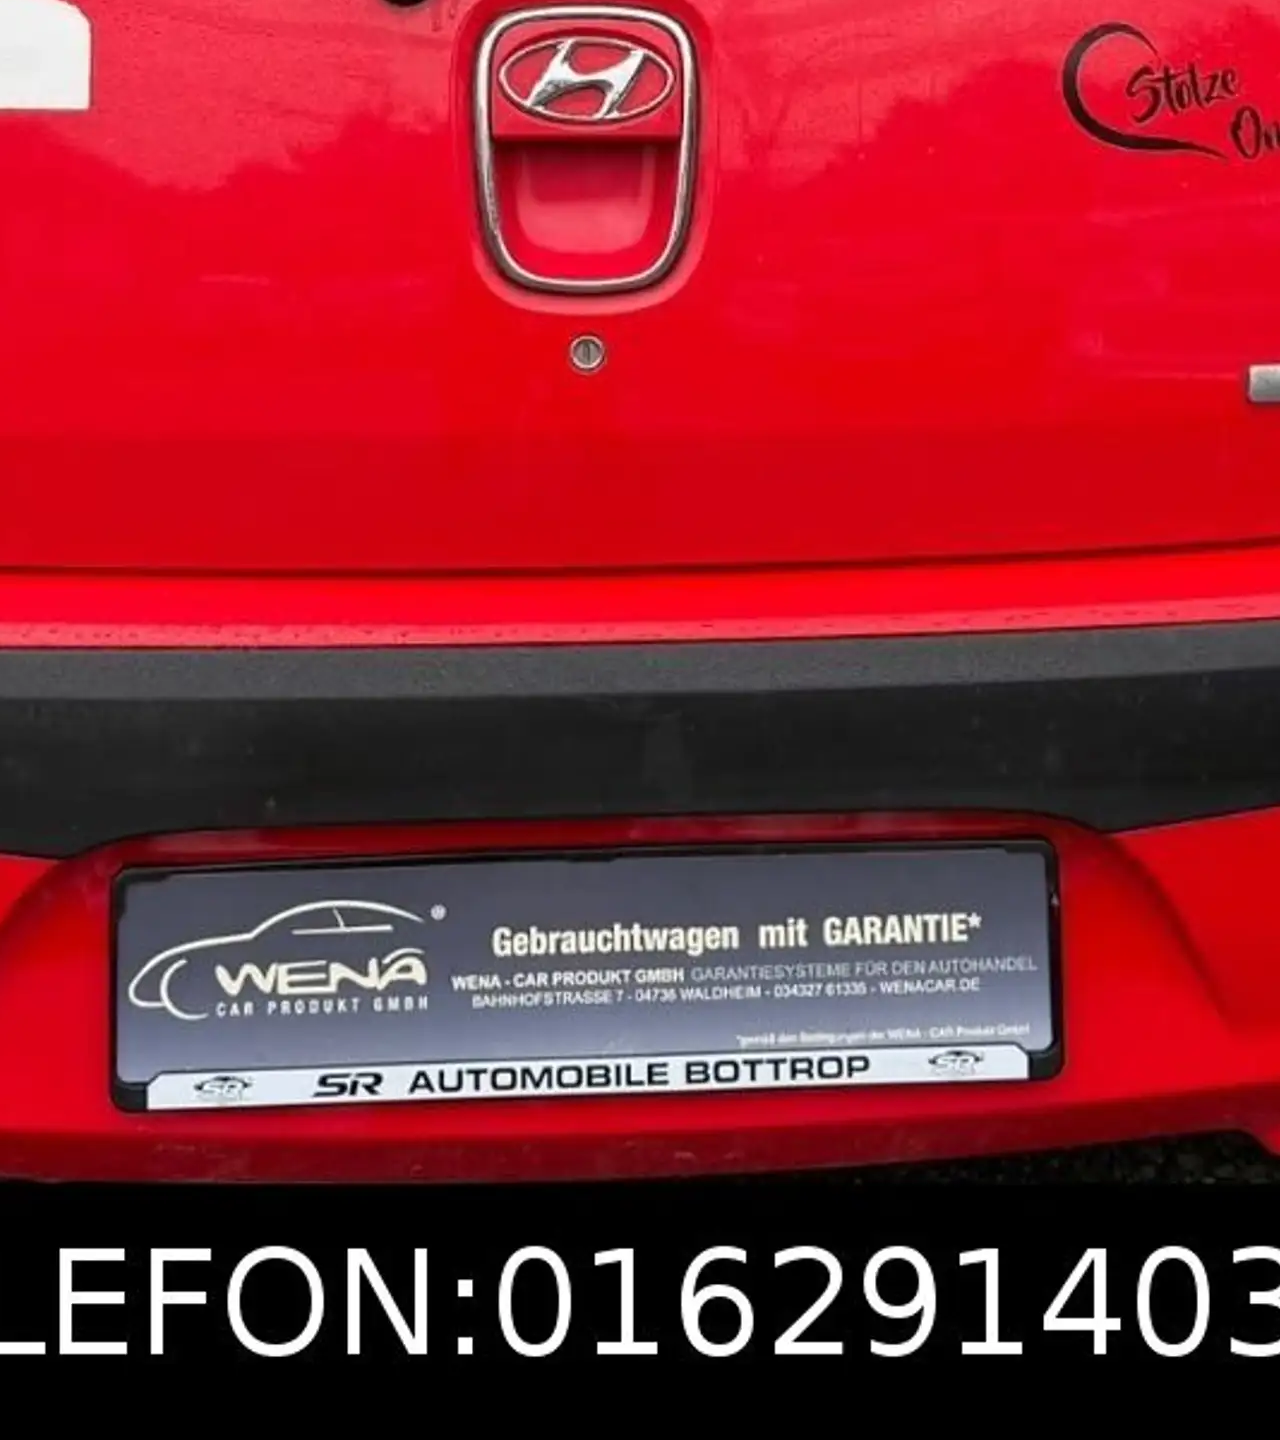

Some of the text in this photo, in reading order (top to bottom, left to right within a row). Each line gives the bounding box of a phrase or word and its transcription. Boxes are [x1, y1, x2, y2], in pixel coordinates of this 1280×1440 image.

[1126, 64, 1240, 124] Stolze
[491, 922, 740, 957] Gebrauchtwagen
[759, 917, 808, 949] mit
[215, 947, 428, 996] WENA
[451, 973, 501, 992] WENA
[512, 970, 548, 989] CAR
[552, 968, 631, 987] PRODUKT
[635, 966, 685, 984] GMBH
[690, 960, 850, 983] GARANTIESYSTEME
[891, 958, 925, 975] DEN
[928, 955, 1037, 973] AUTOHANDEL
[216, 994, 428, 1017] CAR PRODUKT GMBH
[472, 988, 613, 1009] BAHNHOFSTRASSE
[679, 983, 761, 1002] WALDHEIM
[312, 1055, 870, 1098] SR AUTOMOBILE BOTTROP
